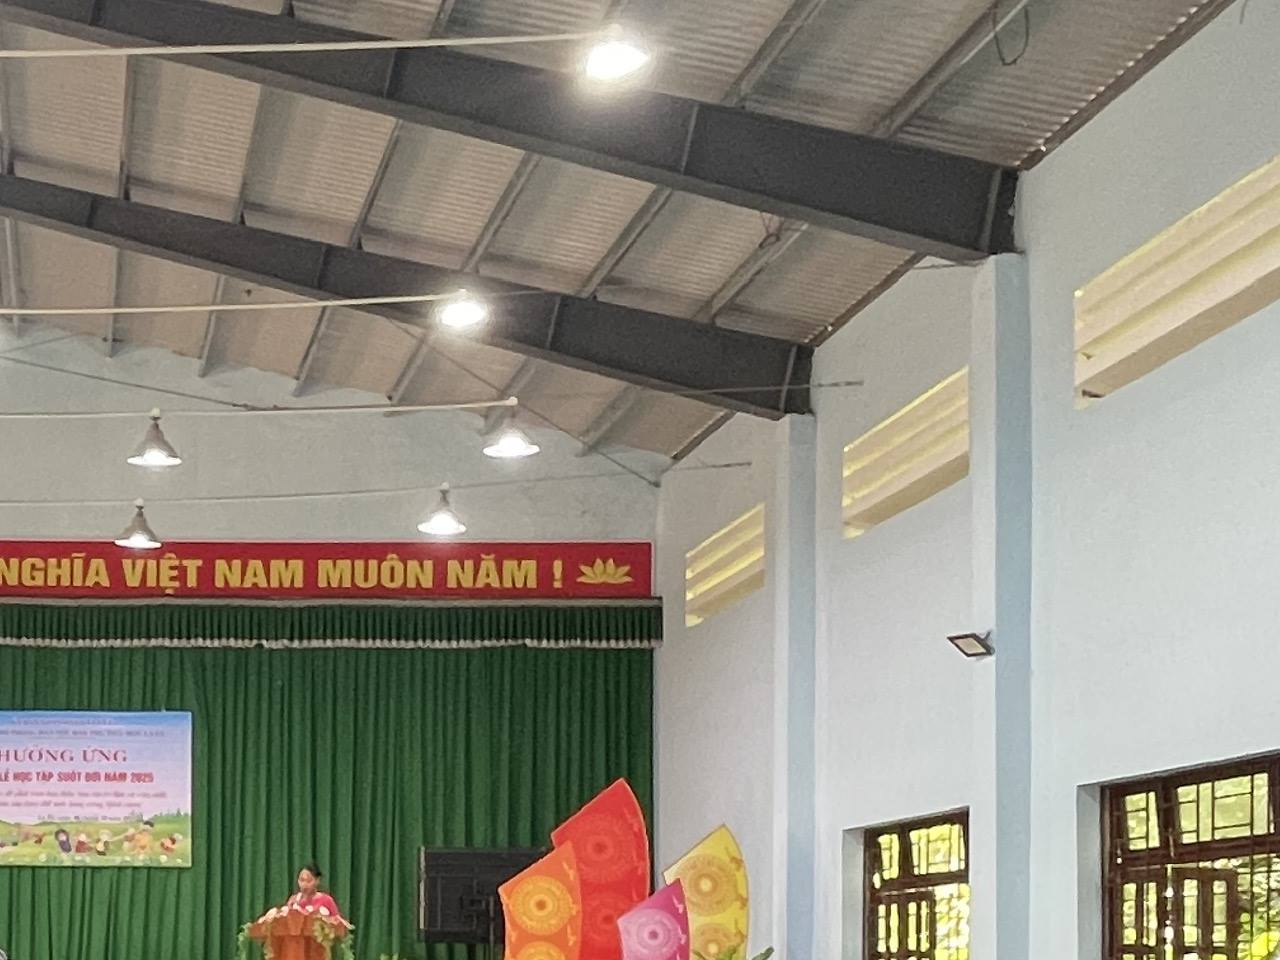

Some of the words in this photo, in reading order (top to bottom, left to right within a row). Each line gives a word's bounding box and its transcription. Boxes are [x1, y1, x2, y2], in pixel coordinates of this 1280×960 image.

[121, 552, 203, 595] VIỆT
[214, 559, 304, 588] NAM
[317, 553, 434, 589] MUÔN
[446, 551, 537, 589] NĂM
[552, 559, 563, 589] !
[130, 771, 154, 783] 2025
